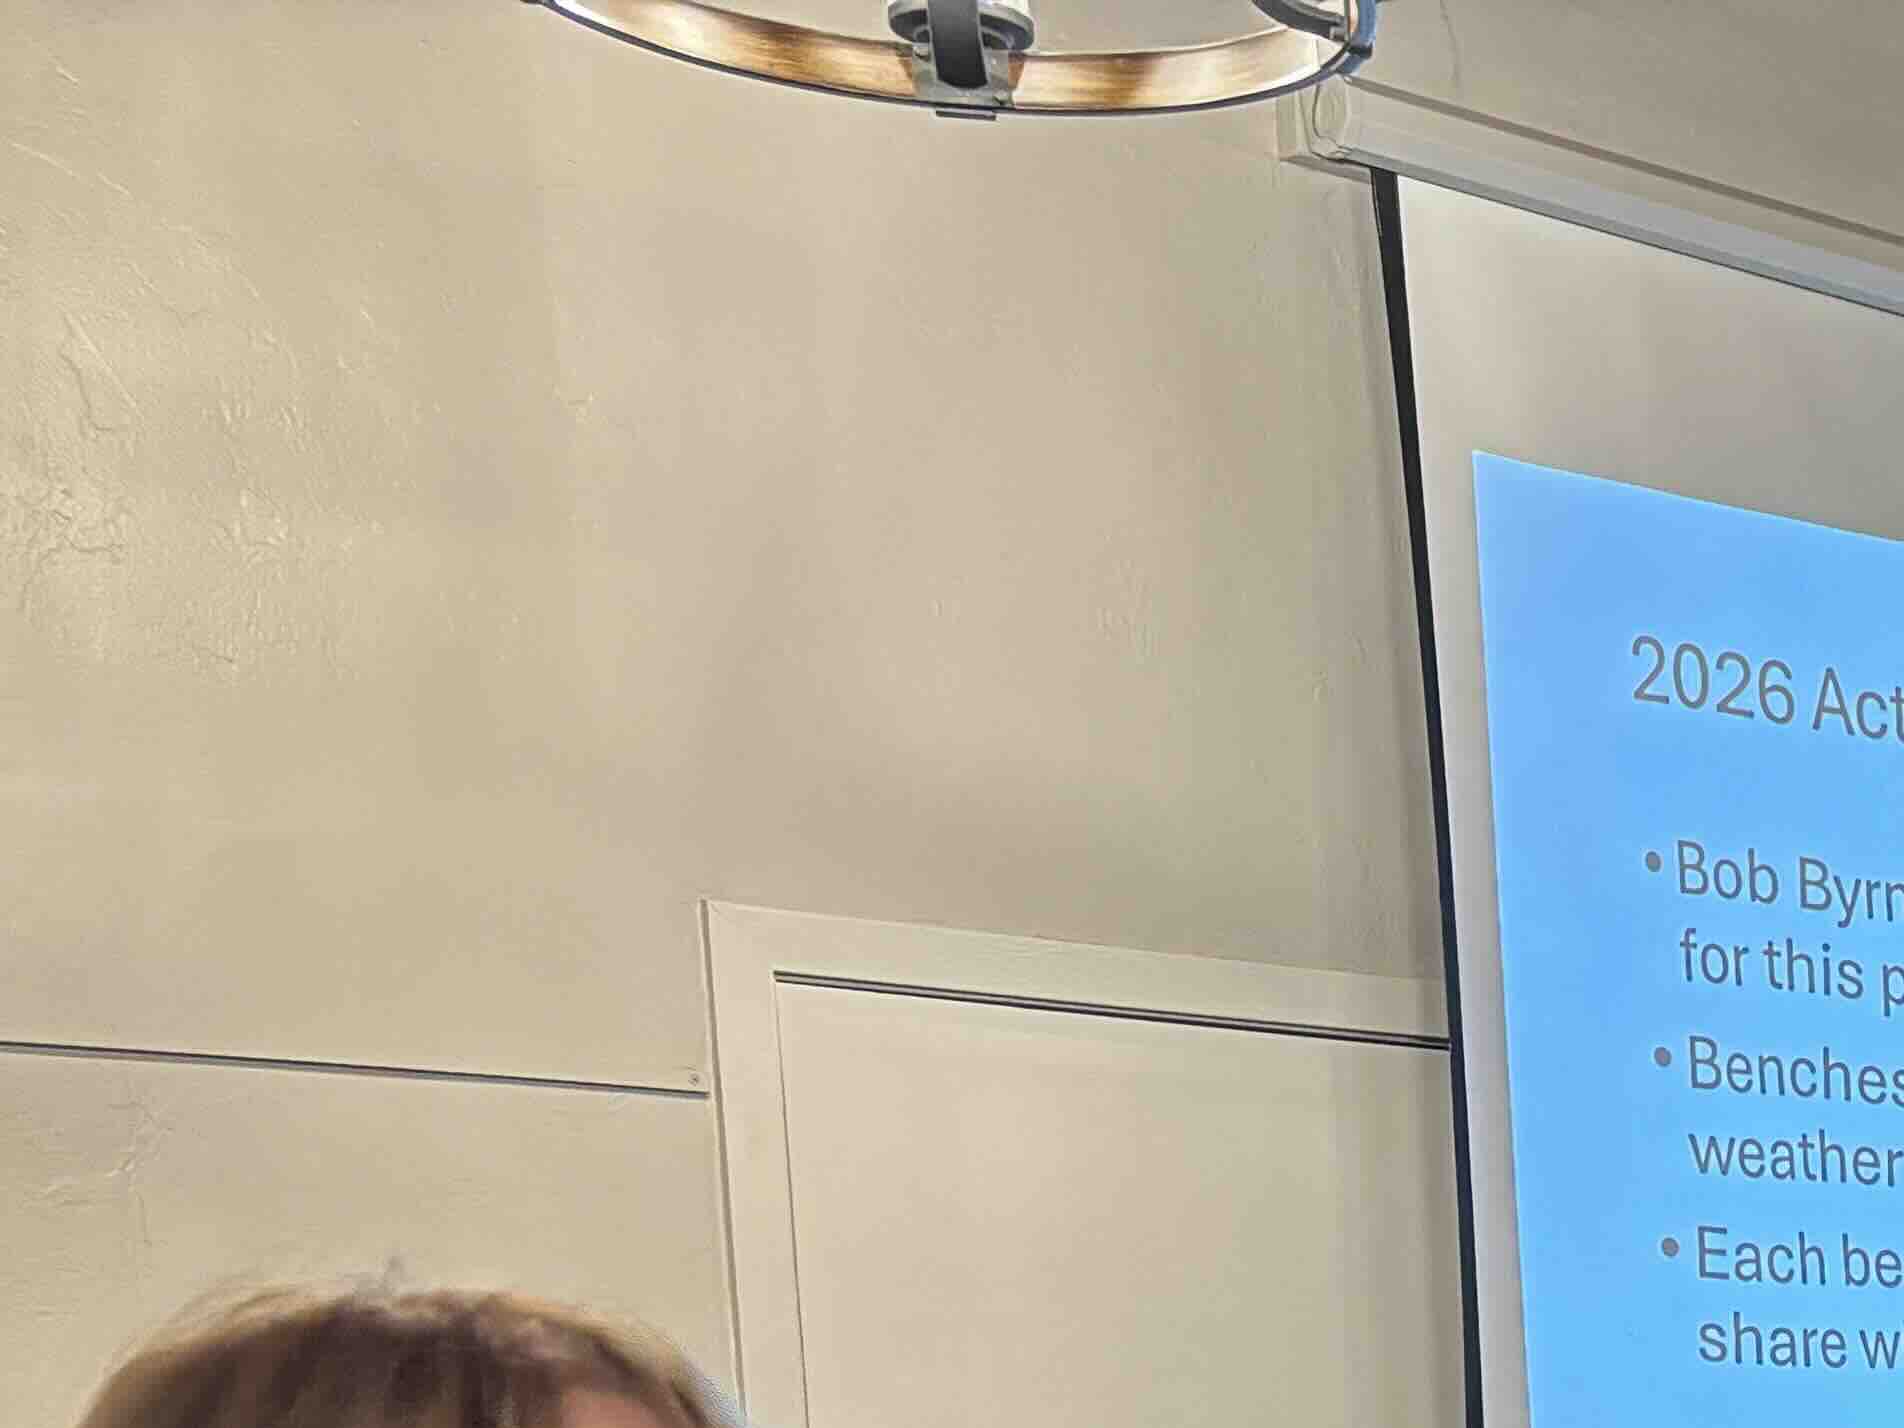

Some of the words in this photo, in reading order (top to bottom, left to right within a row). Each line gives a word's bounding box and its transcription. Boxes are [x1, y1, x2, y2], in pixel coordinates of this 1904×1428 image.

[1630, 634, 1796, 726] 2026
[1676, 838, 1780, 906] Bob
[1678, 926, 1751, 988] for
[1760, 936, 1865, 1001] this
[1696, 1224, 1828, 1287] Each
[1698, 1310, 1848, 1370] share
